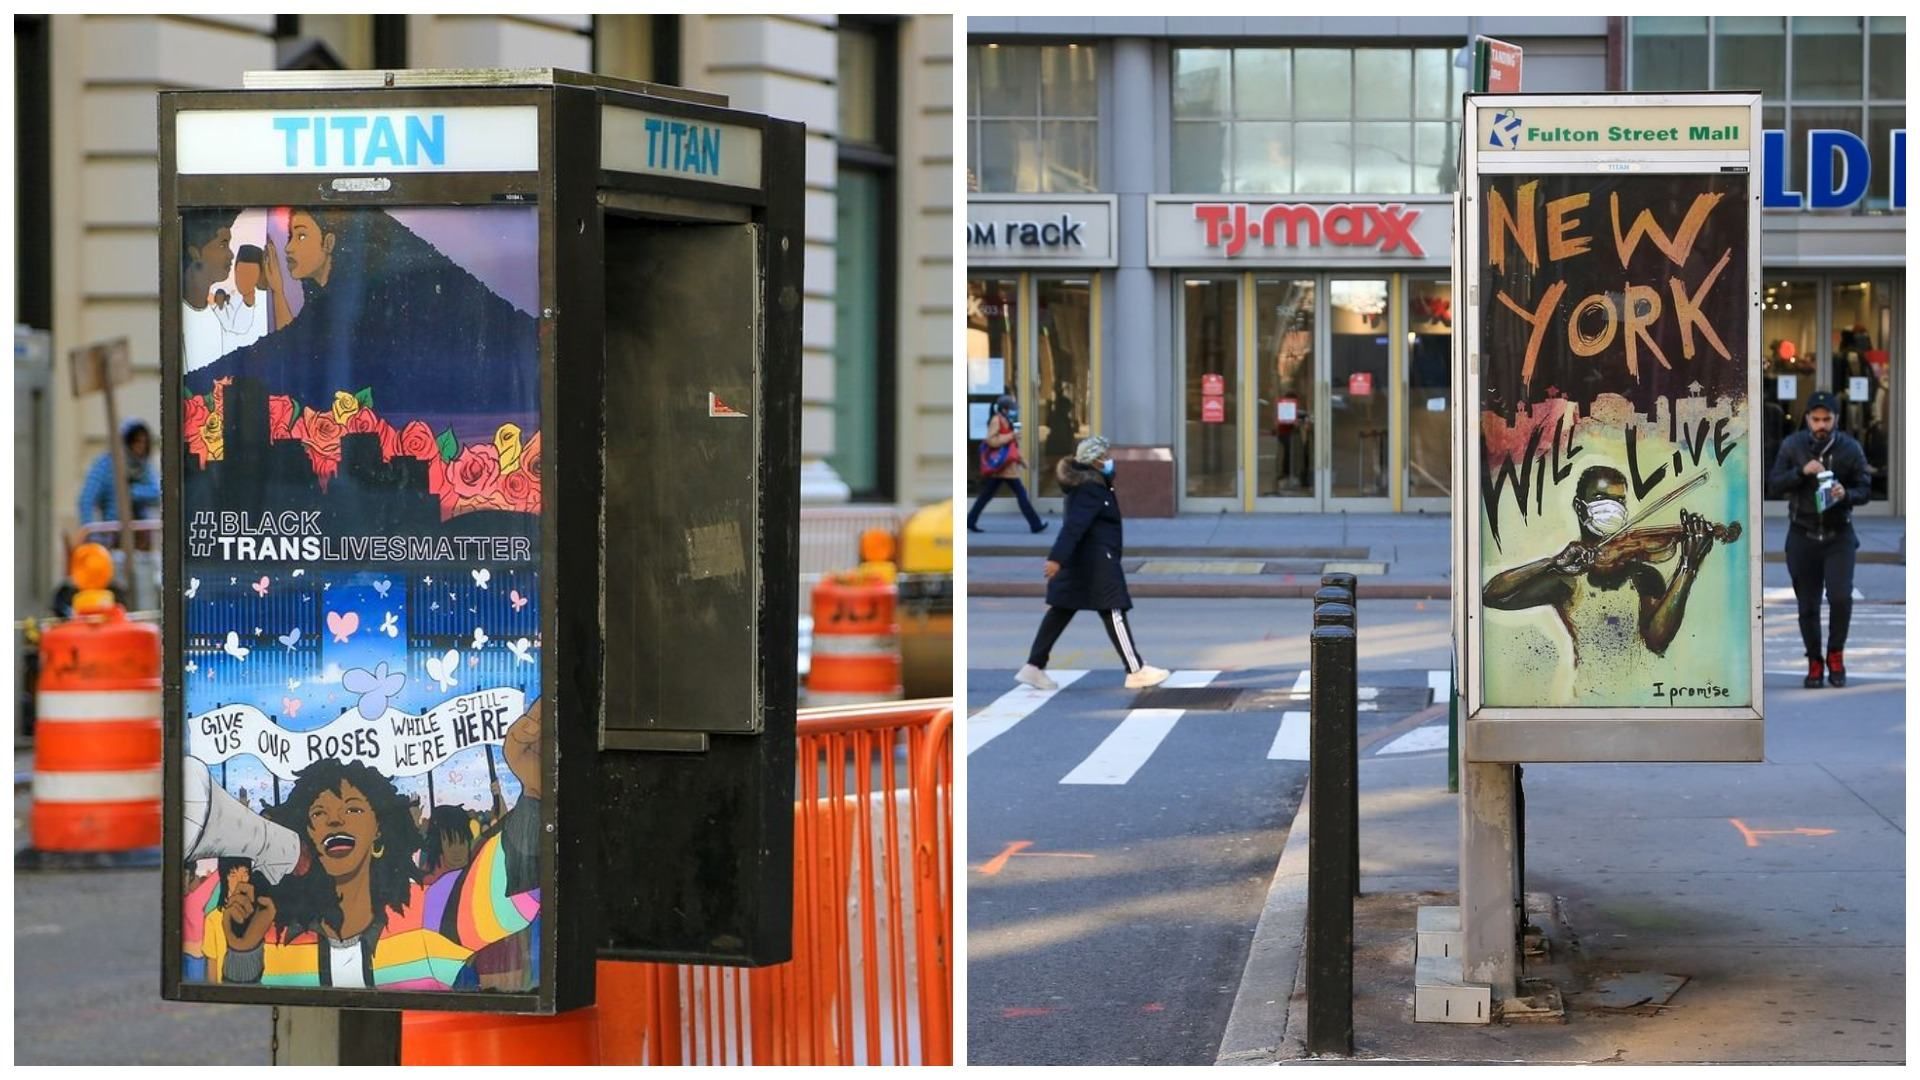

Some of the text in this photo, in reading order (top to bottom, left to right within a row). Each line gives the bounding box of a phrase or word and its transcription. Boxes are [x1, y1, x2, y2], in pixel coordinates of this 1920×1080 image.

[274, 115, 446, 167] TITAN
[644, 118, 721, 176] TITAN
[1527, 126, 1740, 142] Fulton Street Mall
[1006, 214, 1082, 246] rack
[1487, 179, 1725, 276] NEW
[1497, 247, 1732, 396] YORK
[1480, 413, 1738, 554] WILL LIVE
[189, 511, 322, 556] #BLACK
[218, 536, 531, 561] TRANSLIVESMATTER
[1652, 681, 1730, 707] I promise
[201, 711, 245, 736] GIVE
[214, 728, 242, 755] US
[390, 712, 441, 737] WHILE
[452, 706, 510, 749] HERE
[258, 727, 381, 764] OUR ROSES
[393, 734, 448, 769] WE'RE
